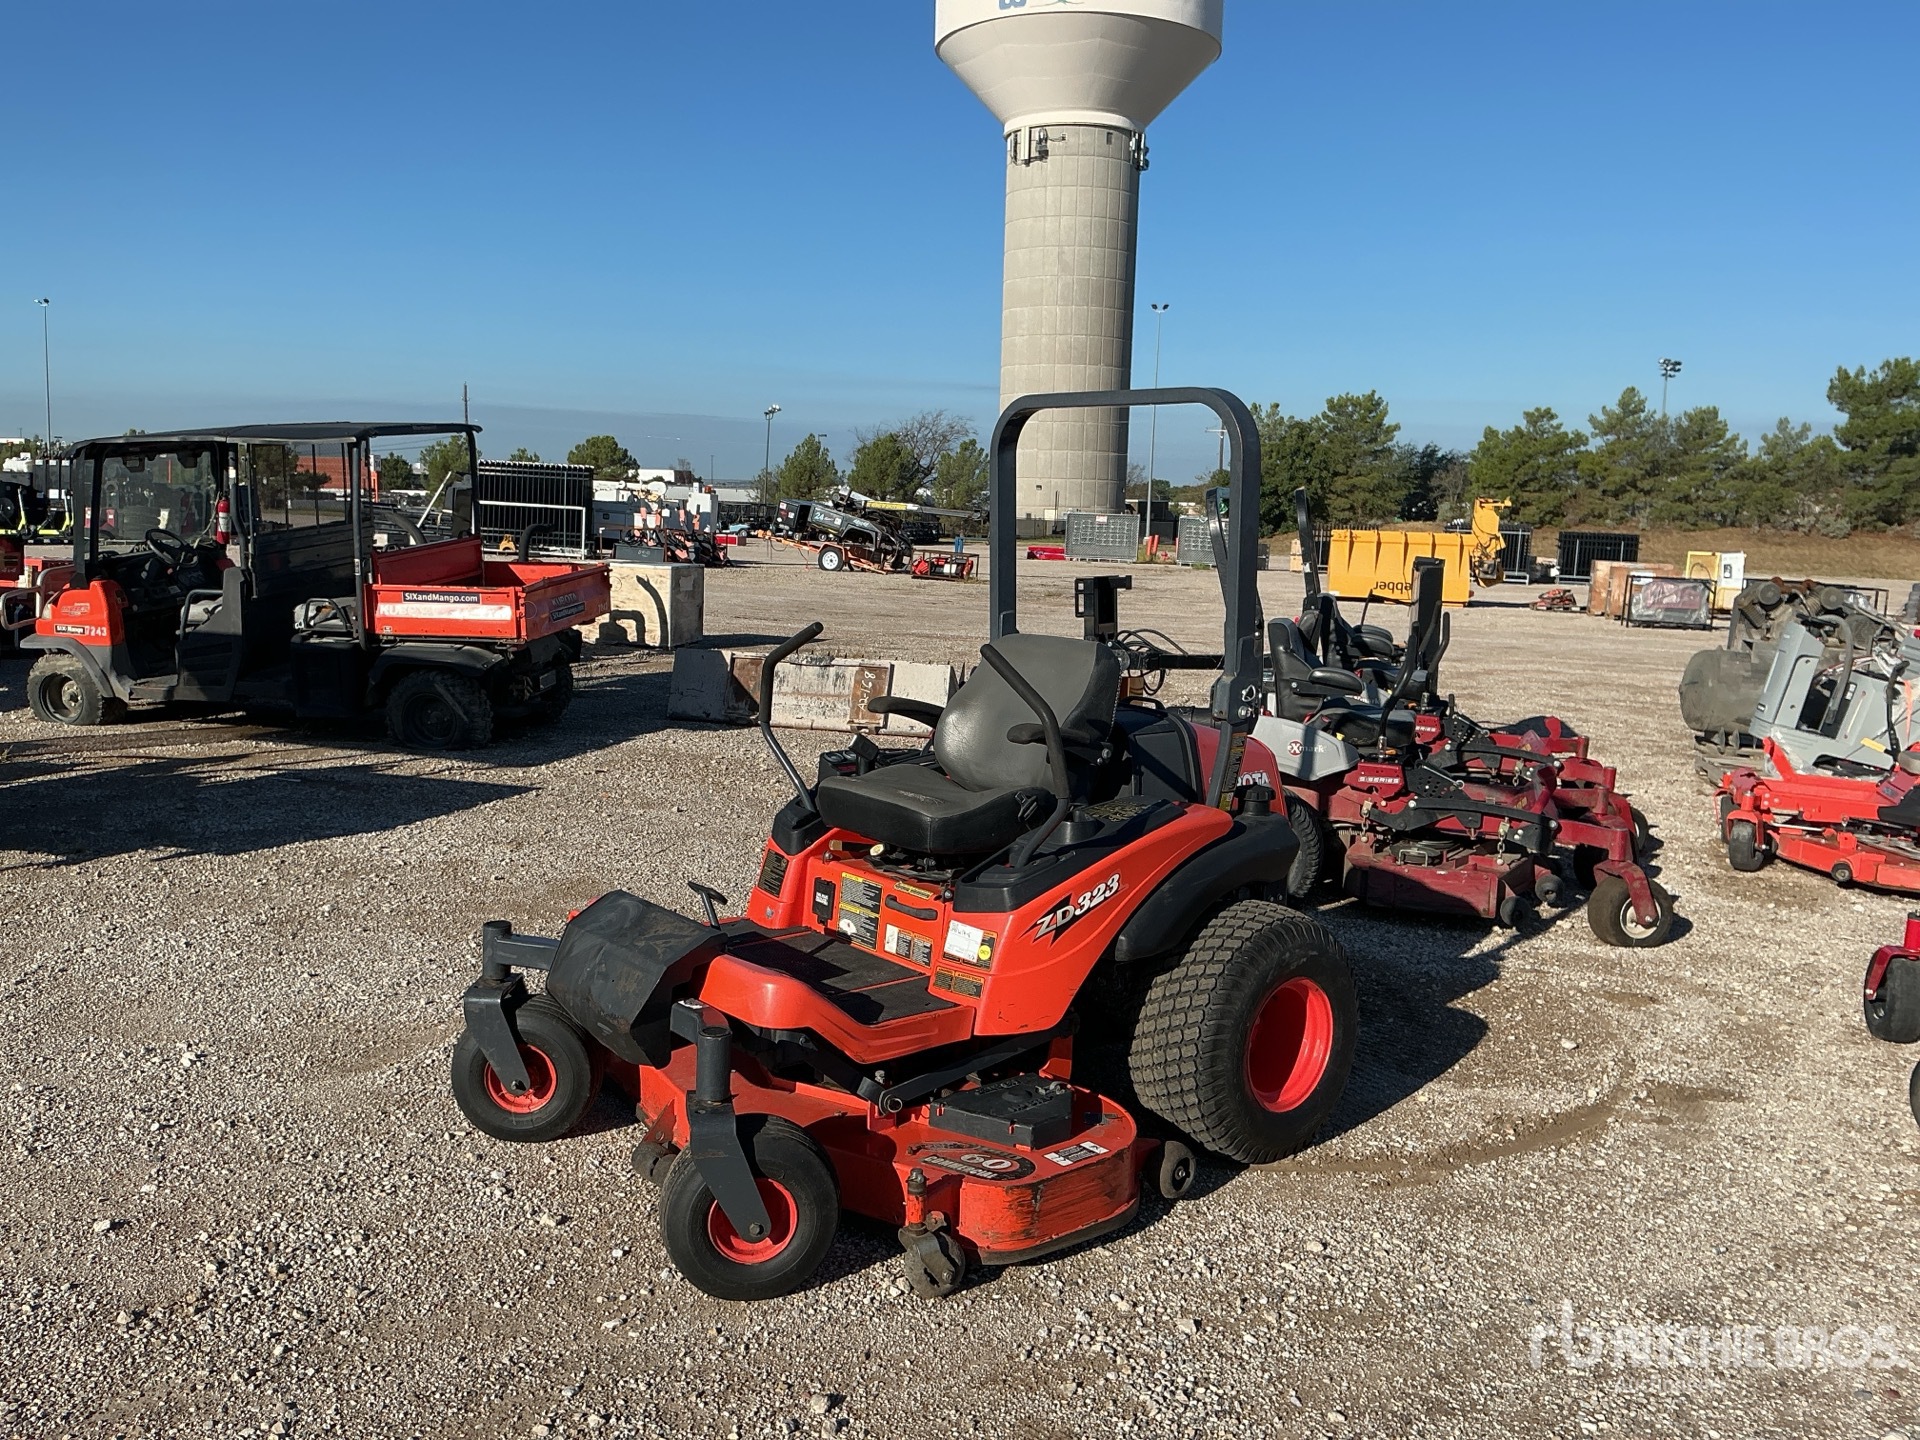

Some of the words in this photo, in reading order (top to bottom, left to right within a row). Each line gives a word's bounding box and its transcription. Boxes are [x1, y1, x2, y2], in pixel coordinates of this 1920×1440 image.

[404, 592, 478, 603] SIXandMango.com
[552, 593, 577, 606] KUBOTA
[1034, 873, 1120, 940] ZD323
[960, 1153, 1012, 1170] 60
